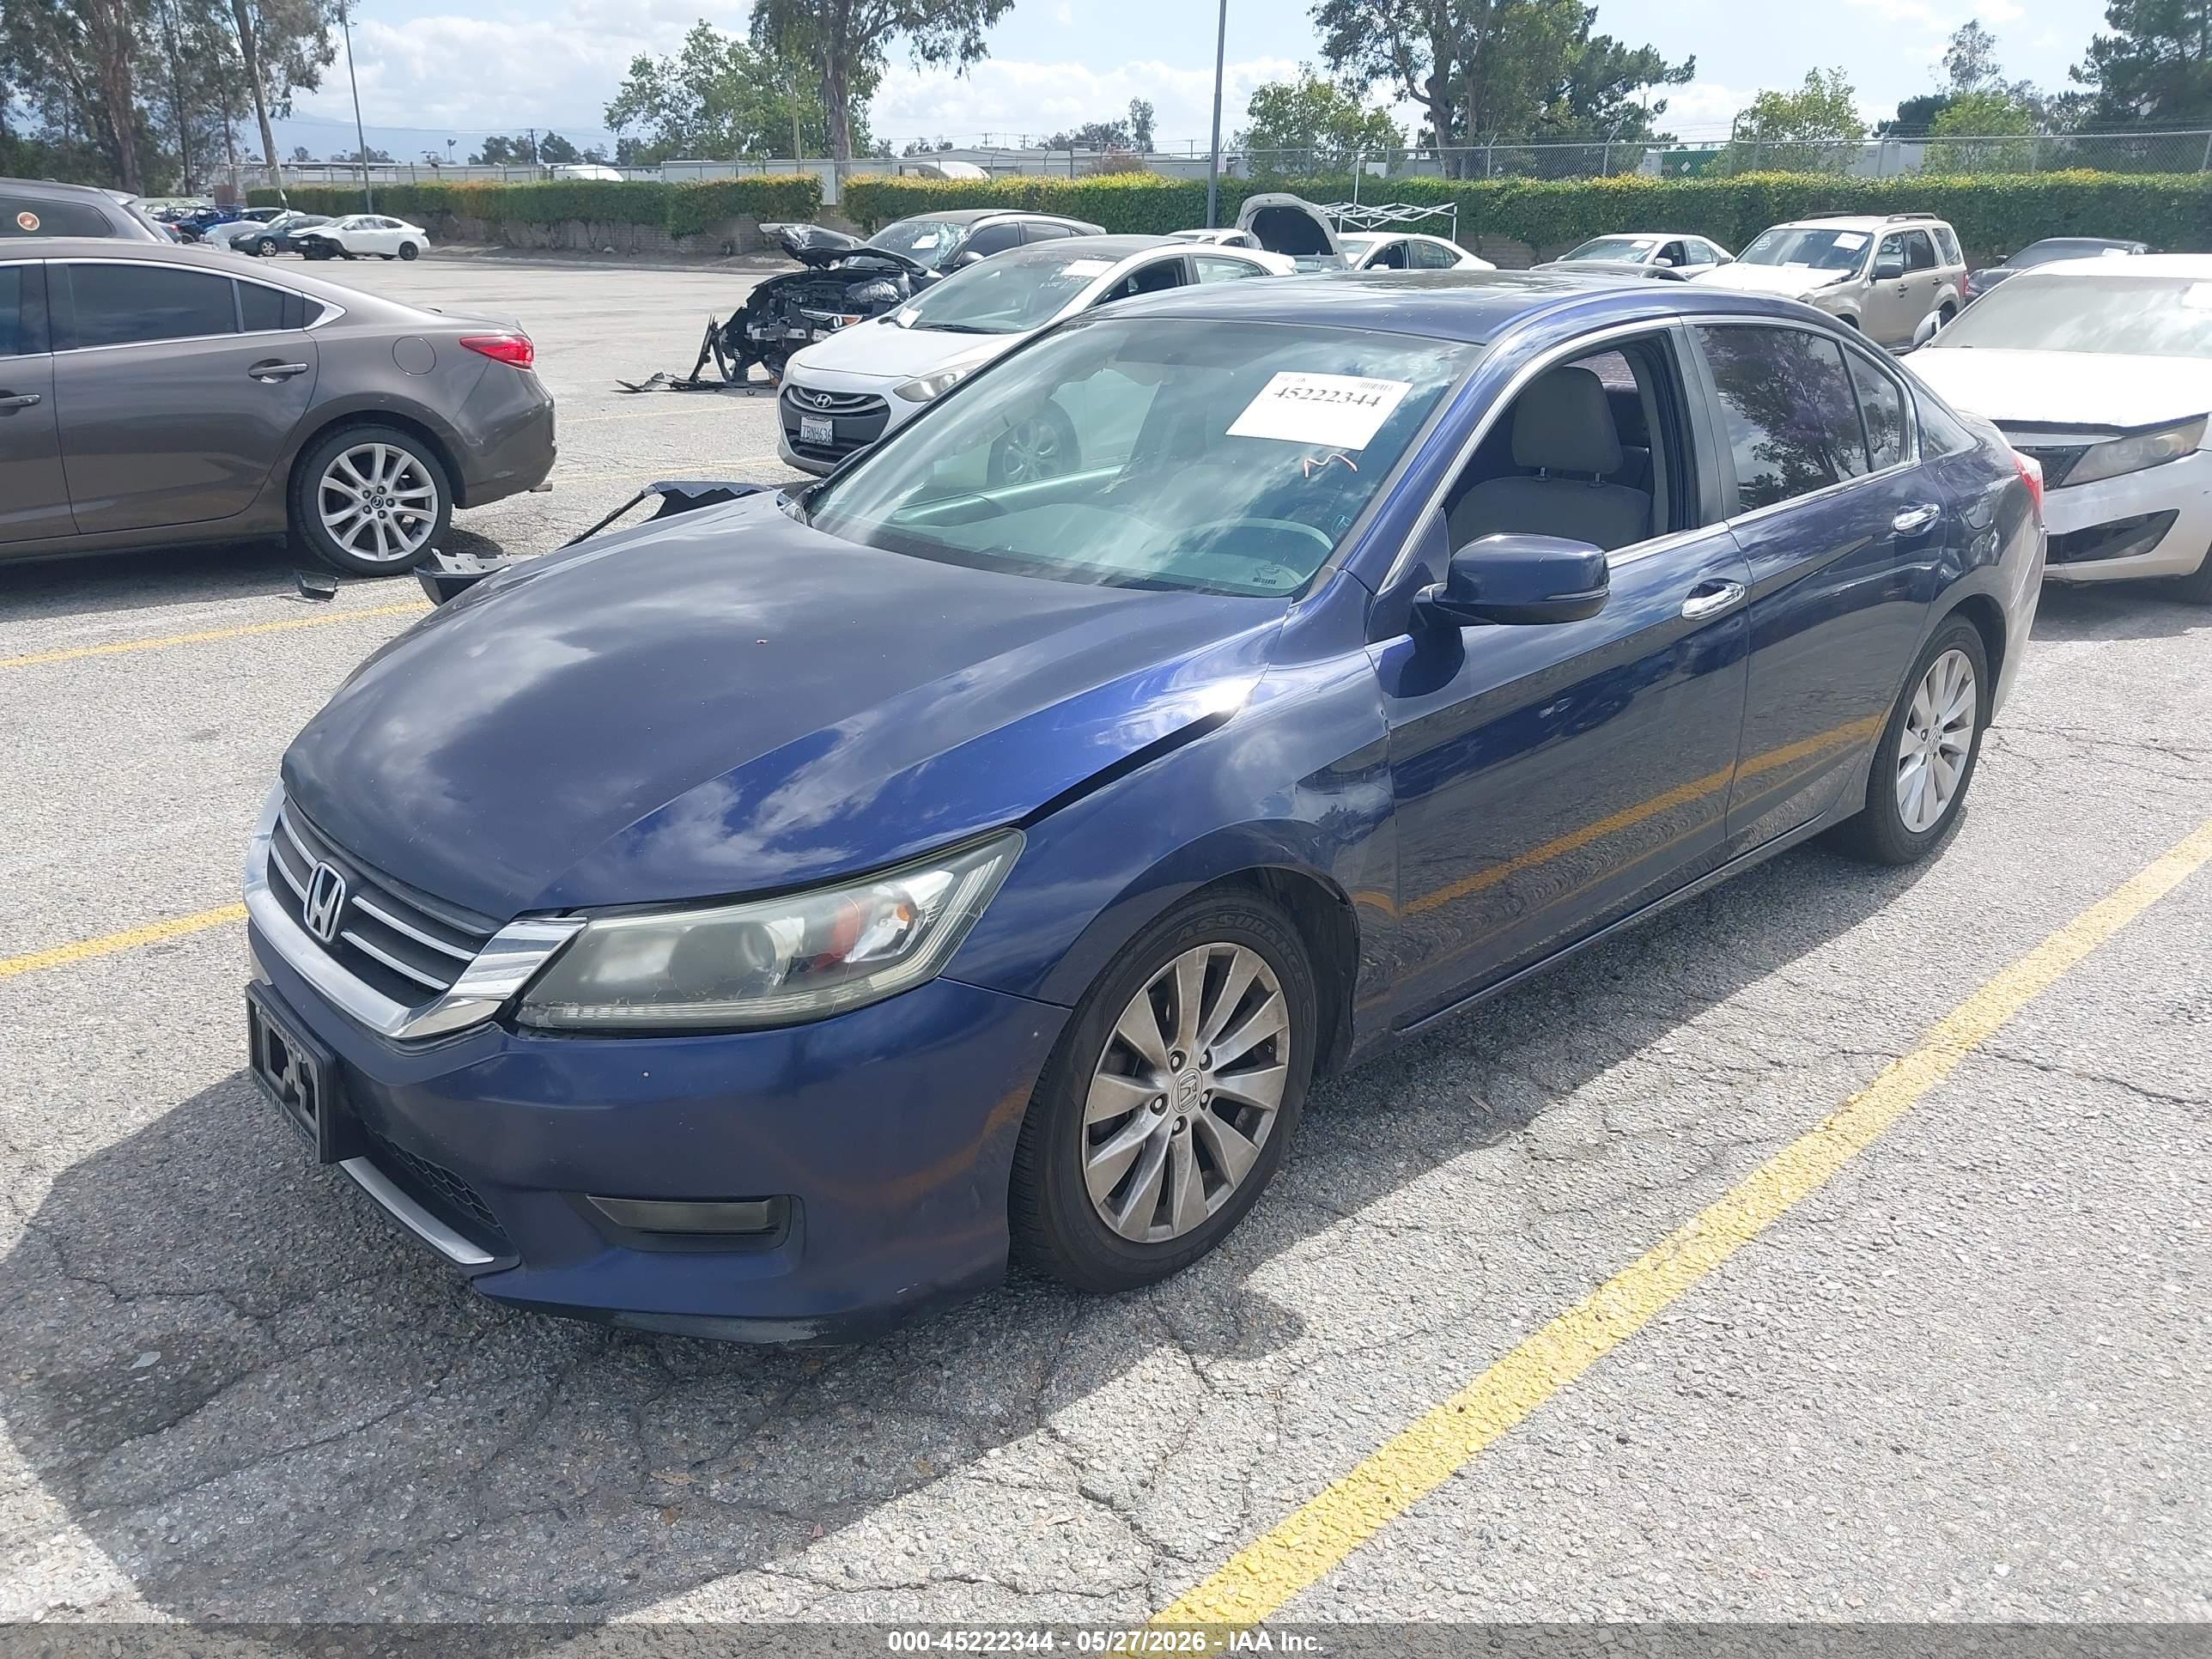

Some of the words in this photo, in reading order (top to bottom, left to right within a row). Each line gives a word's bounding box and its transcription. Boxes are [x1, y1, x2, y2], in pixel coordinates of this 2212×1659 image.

[1273, 386, 1382, 407] 45222344
[1177, 914, 1306, 987] ASSURANCE
[252, 1068, 274, 1105] HONDA
